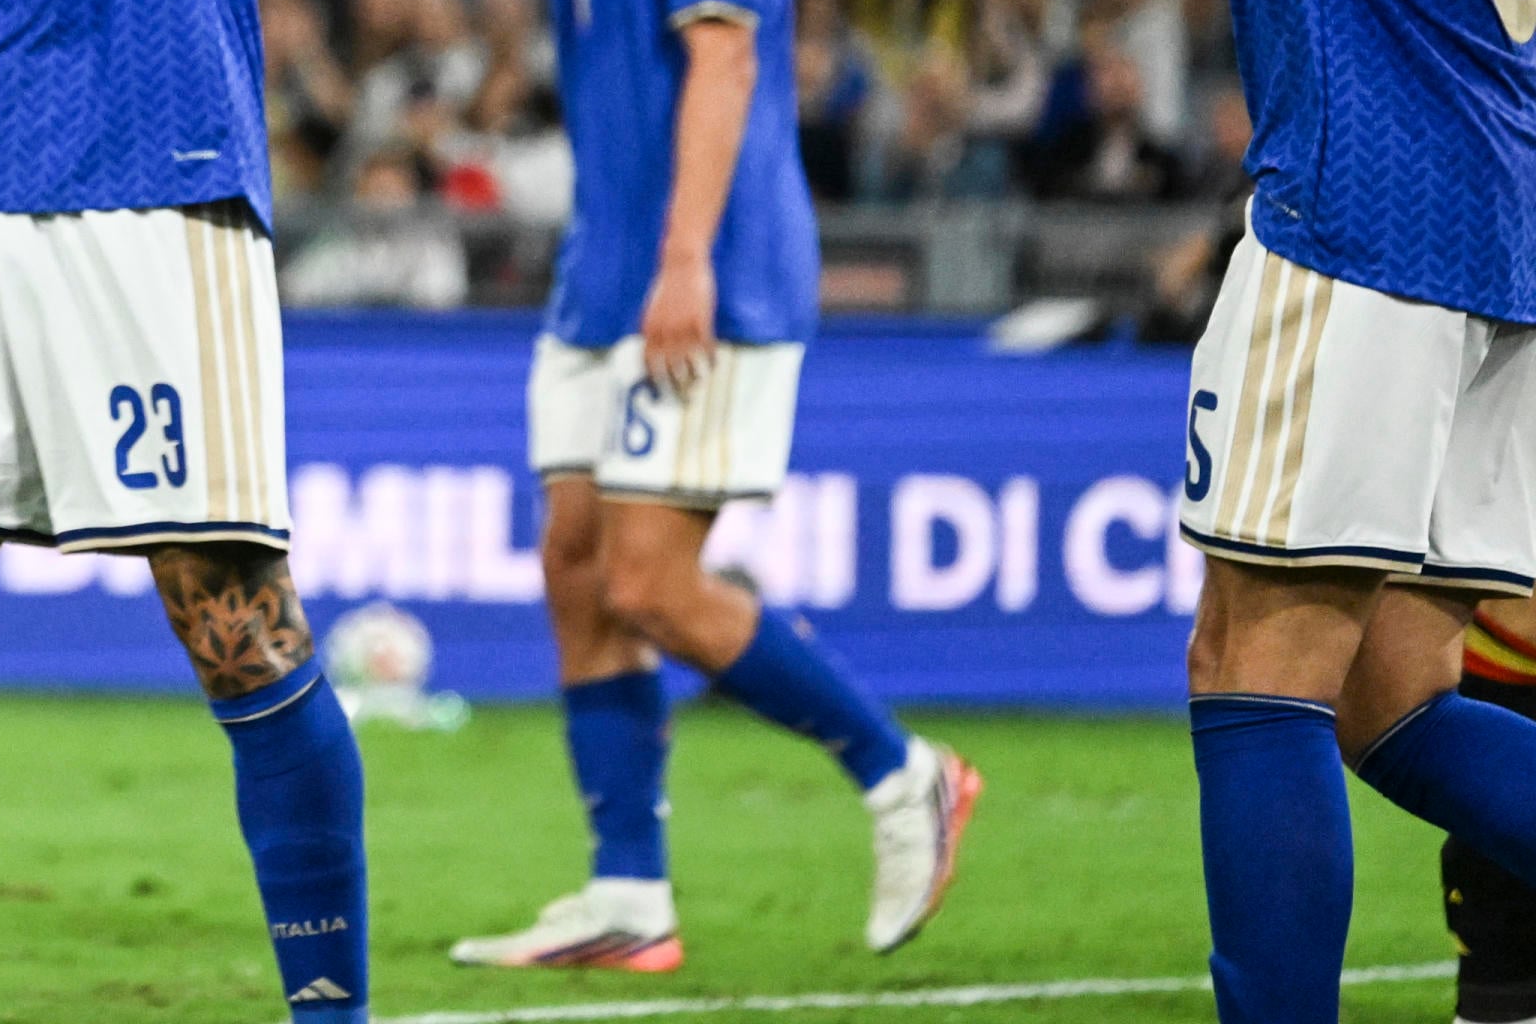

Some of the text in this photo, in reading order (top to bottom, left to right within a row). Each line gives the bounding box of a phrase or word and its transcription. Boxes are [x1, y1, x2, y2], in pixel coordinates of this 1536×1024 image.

[110, 383, 187, 489] 23
[1185, 390, 1218, 502] 5
[888, 472, 1039, 613] DI
